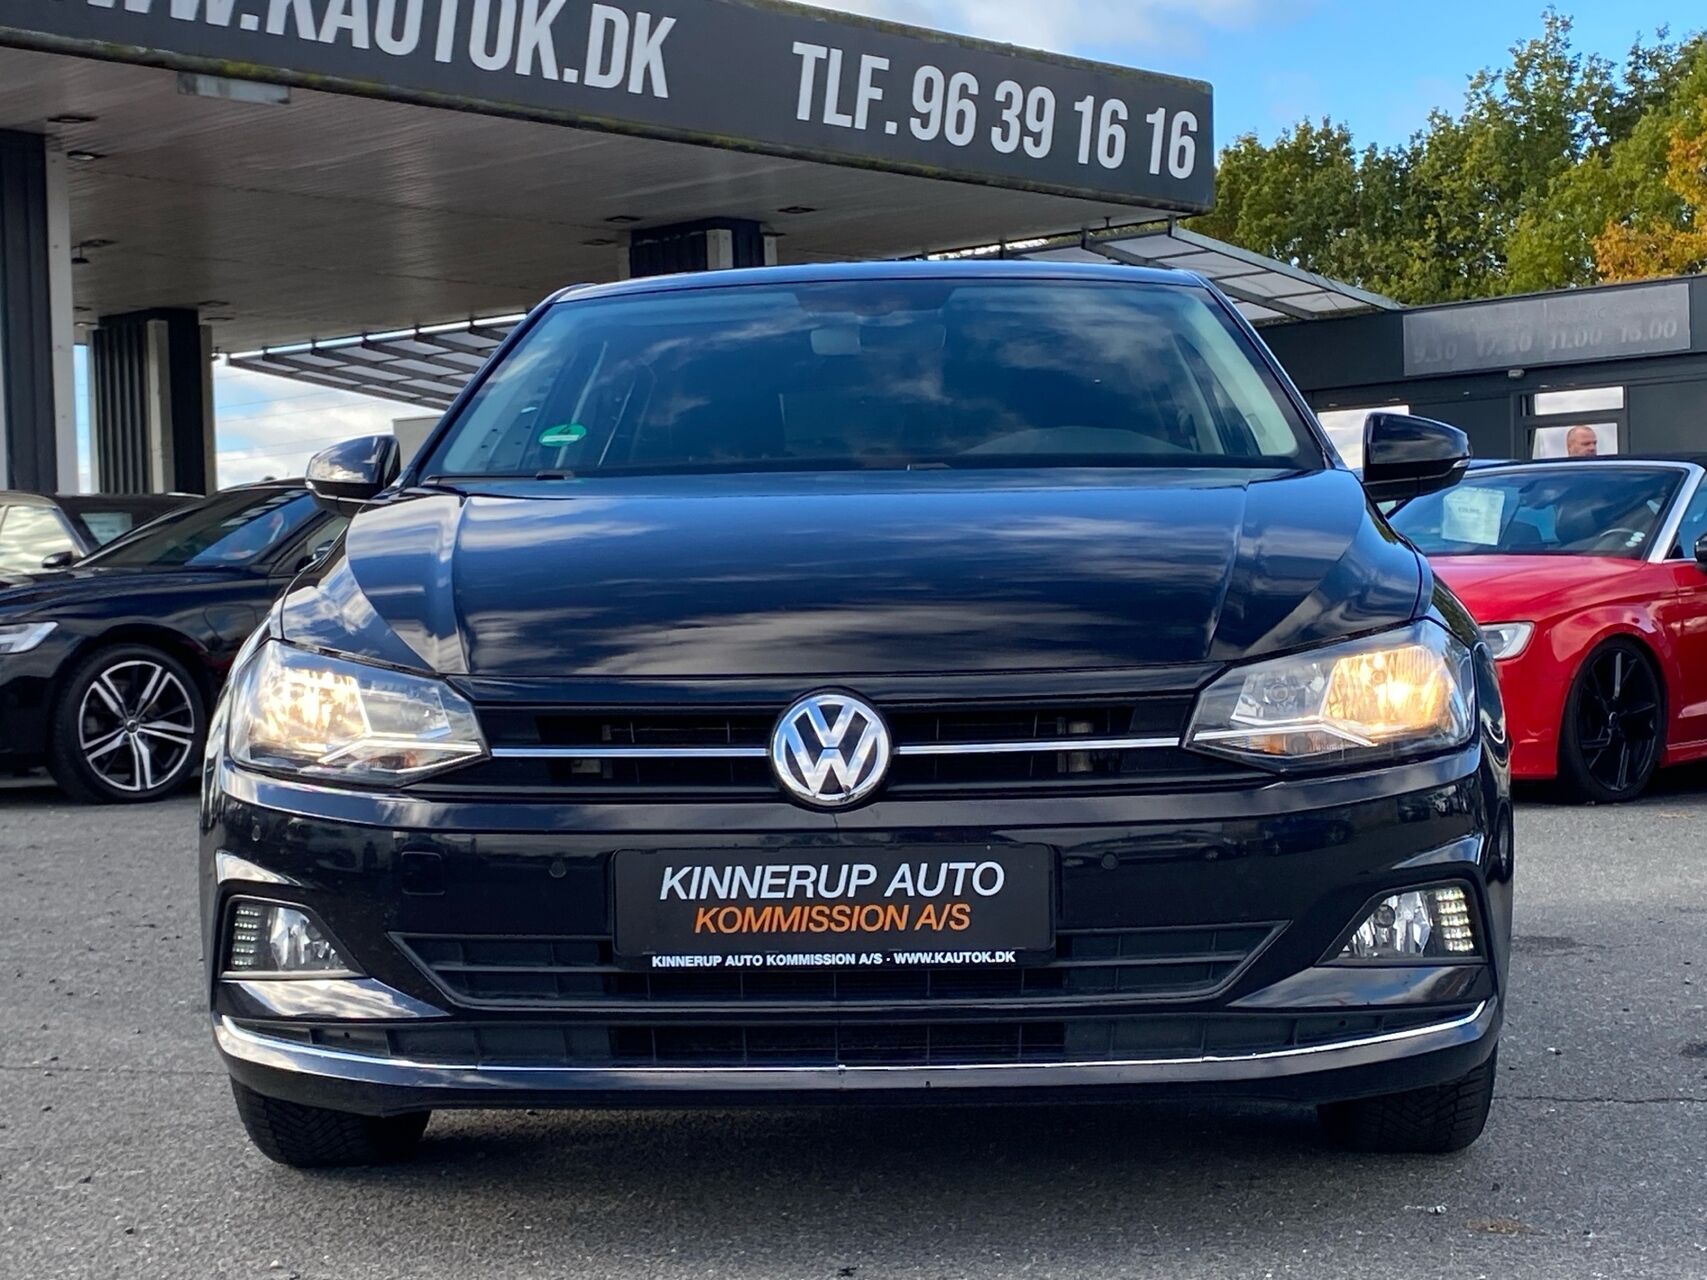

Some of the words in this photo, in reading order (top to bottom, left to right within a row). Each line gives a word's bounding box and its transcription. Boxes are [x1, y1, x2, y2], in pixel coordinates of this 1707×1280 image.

[791, 42, 898, 135] TLF.
[909, 65, 979, 147] 96
[991, 80, 1056, 159] 39
[1074, 95, 1128, 169] 16
[1146, 107, 1198, 180] 16
[659, 864, 877, 901] KINNERUP
[885, 861, 1005, 898] AUTO
[694, 904, 909, 934] KOMMISSION
[914, 903, 971, 932] A/S
[652, 955, 722, 968] KINNERUP
[724, 954, 763, 967] AUTO
[766, 953, 856, 967] KOMMISSION
[859, 952, 883, 965] A/S
[894, 951, 1016, 964] WWW.KAUTOK.DK
